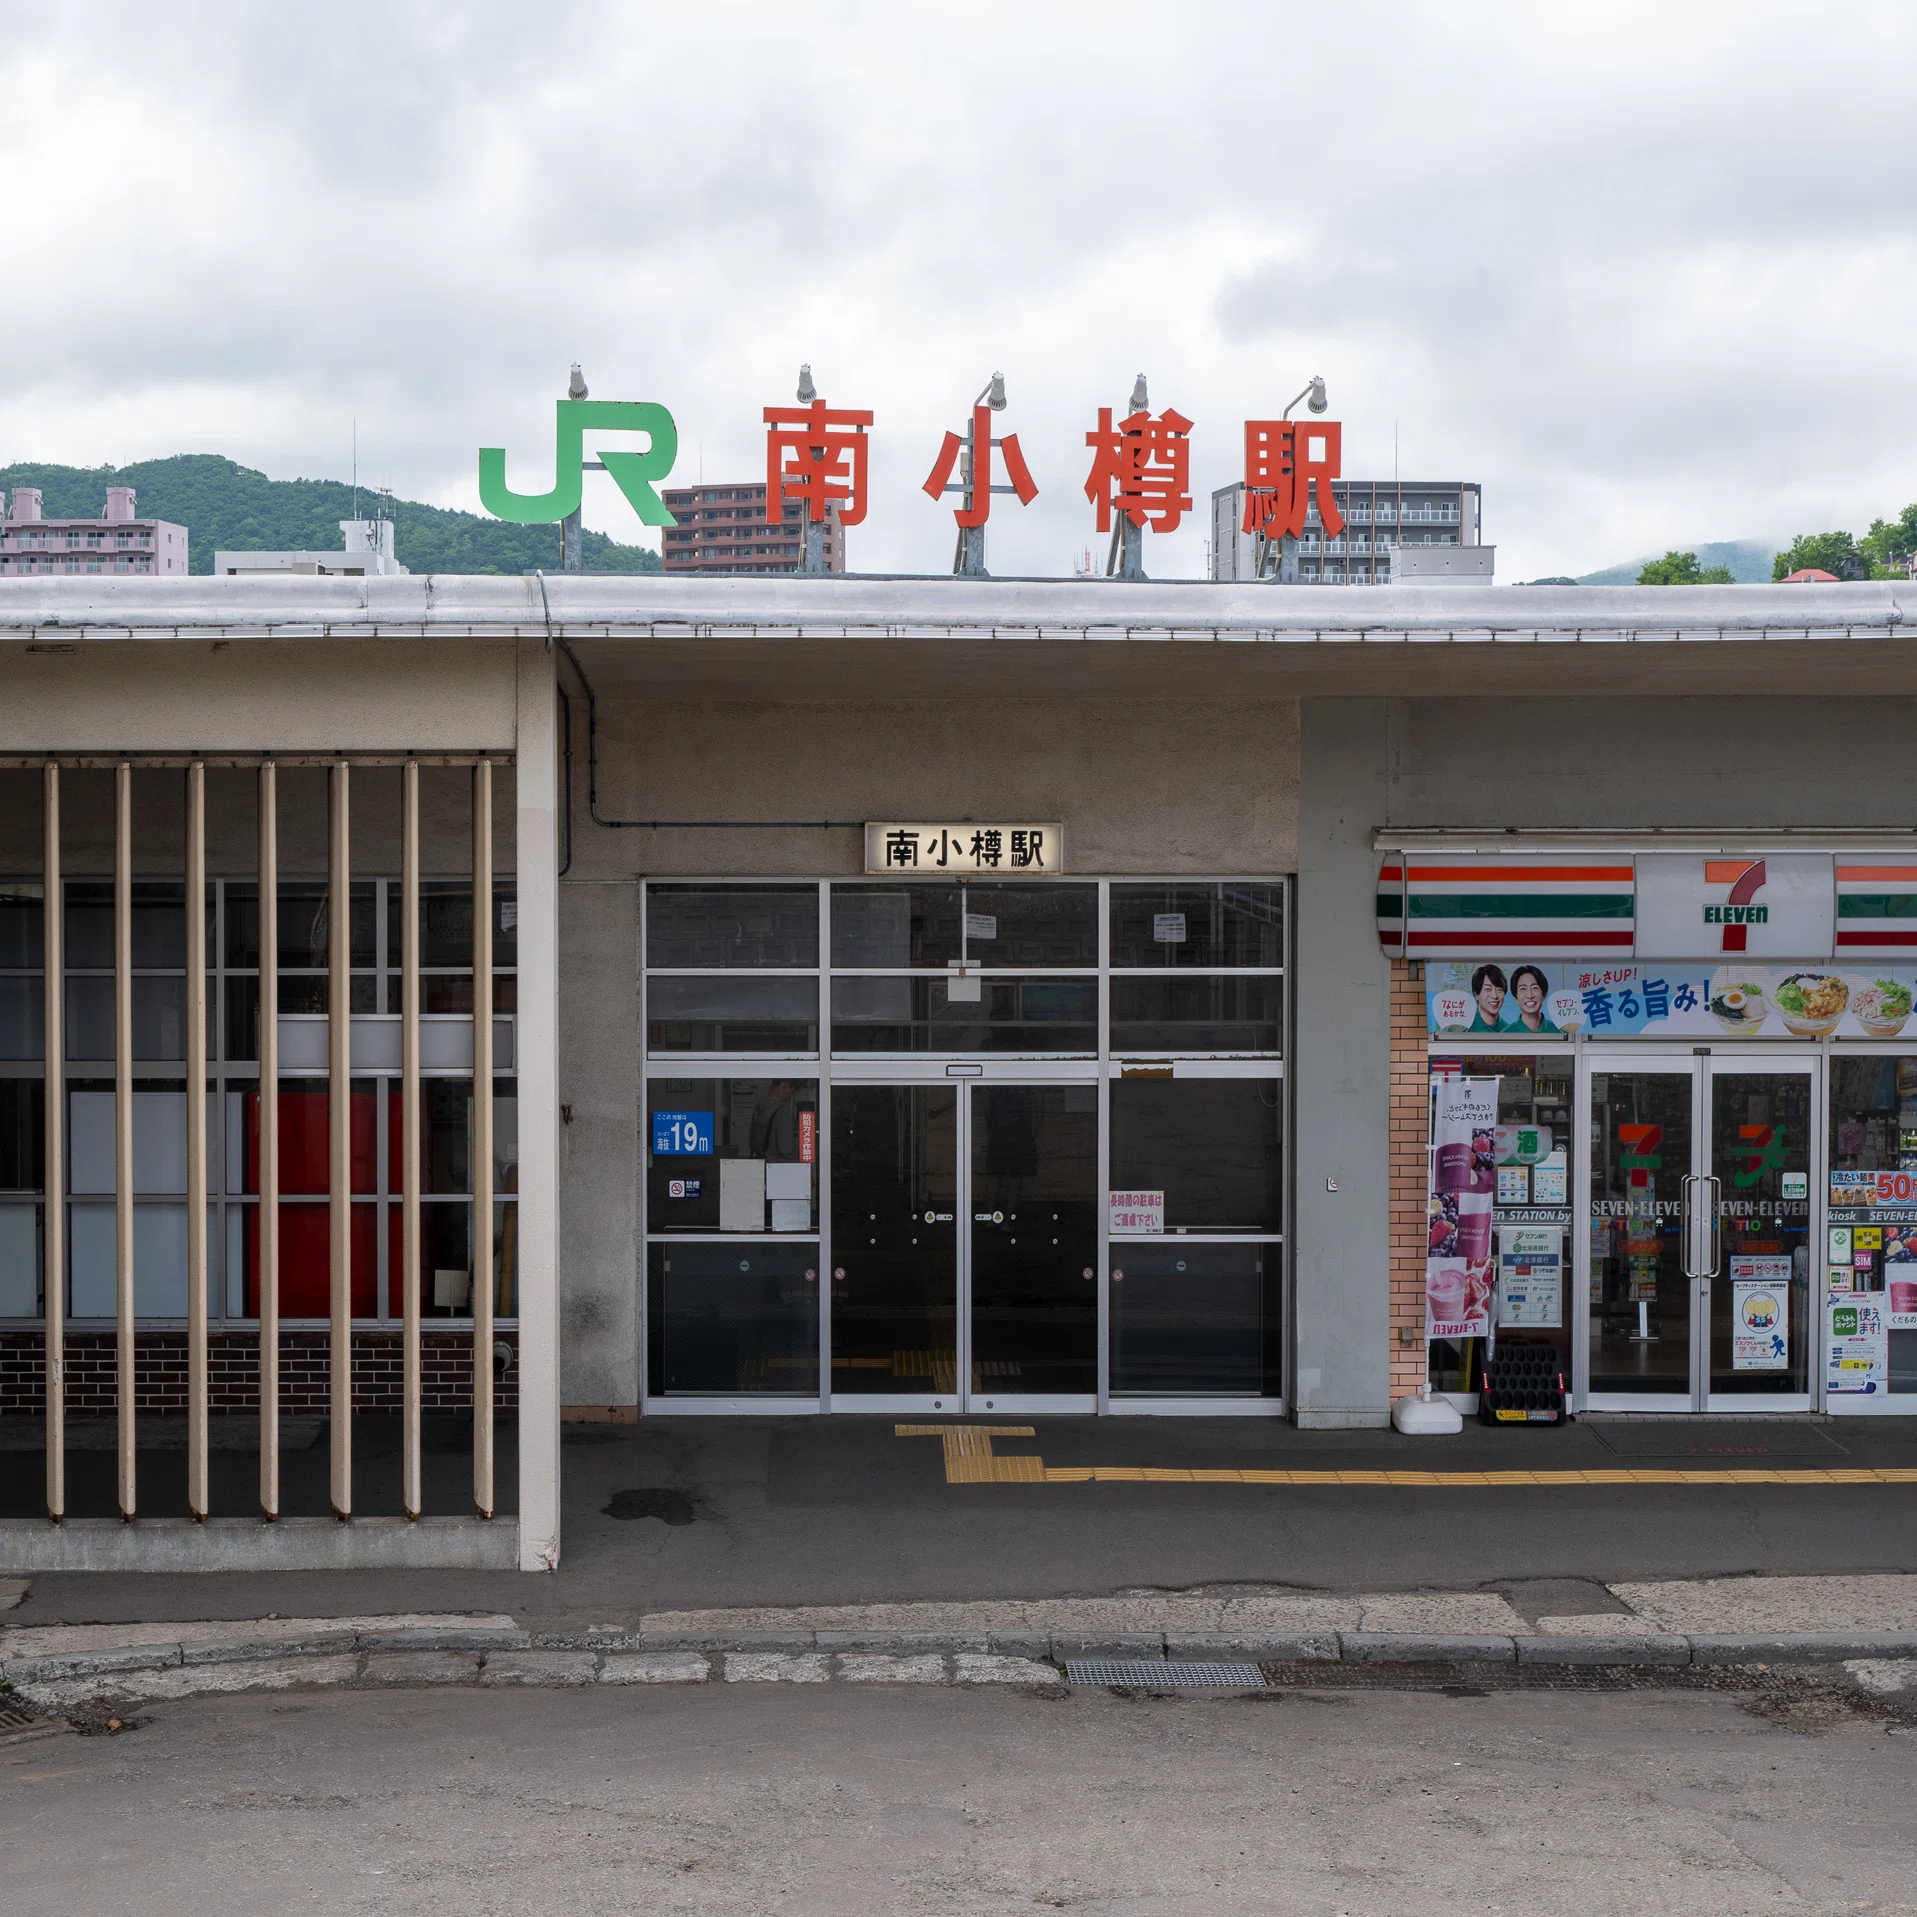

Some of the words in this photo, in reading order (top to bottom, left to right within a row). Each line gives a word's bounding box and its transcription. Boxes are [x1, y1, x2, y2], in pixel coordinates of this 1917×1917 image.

[479, 400, 678, 526] JR
[762, 399, 1342, 538] 南小樽駅
[886, 829, 1044, 867] 南小樽駅
[1578, 967, 1638, 989] 涼しさUP!
[1441, 999, 1465, 1009] 7なにが
[1581, 978, 1711, 1028] 香る旨み!
[802, 1113, 812, 1162] 防犯カメラ作動中
[1517, 1130, 1538, 1154] 酒
[657, 1138, 670, 1151] 海抜
[1835, 1171, 1868, 1182] 冷たい麺
[685, 1180, 700, 1189] 禁煙
[1110, 1194, 1162, 1207] 長時間の駐車は
[1508, 1210, 1555, 1221] STATION
[1557, 1210, 1572, 1223] by
[1827, 1210, 1857, 1221] kiosk
[1855, 1256, 1871, 1266] SIM
[1858, 1307, 1882, 1322] 使え
[1891, 1315, 1917, 1324] くだもの
[1859, 1322, 1881, 1335] ます!
